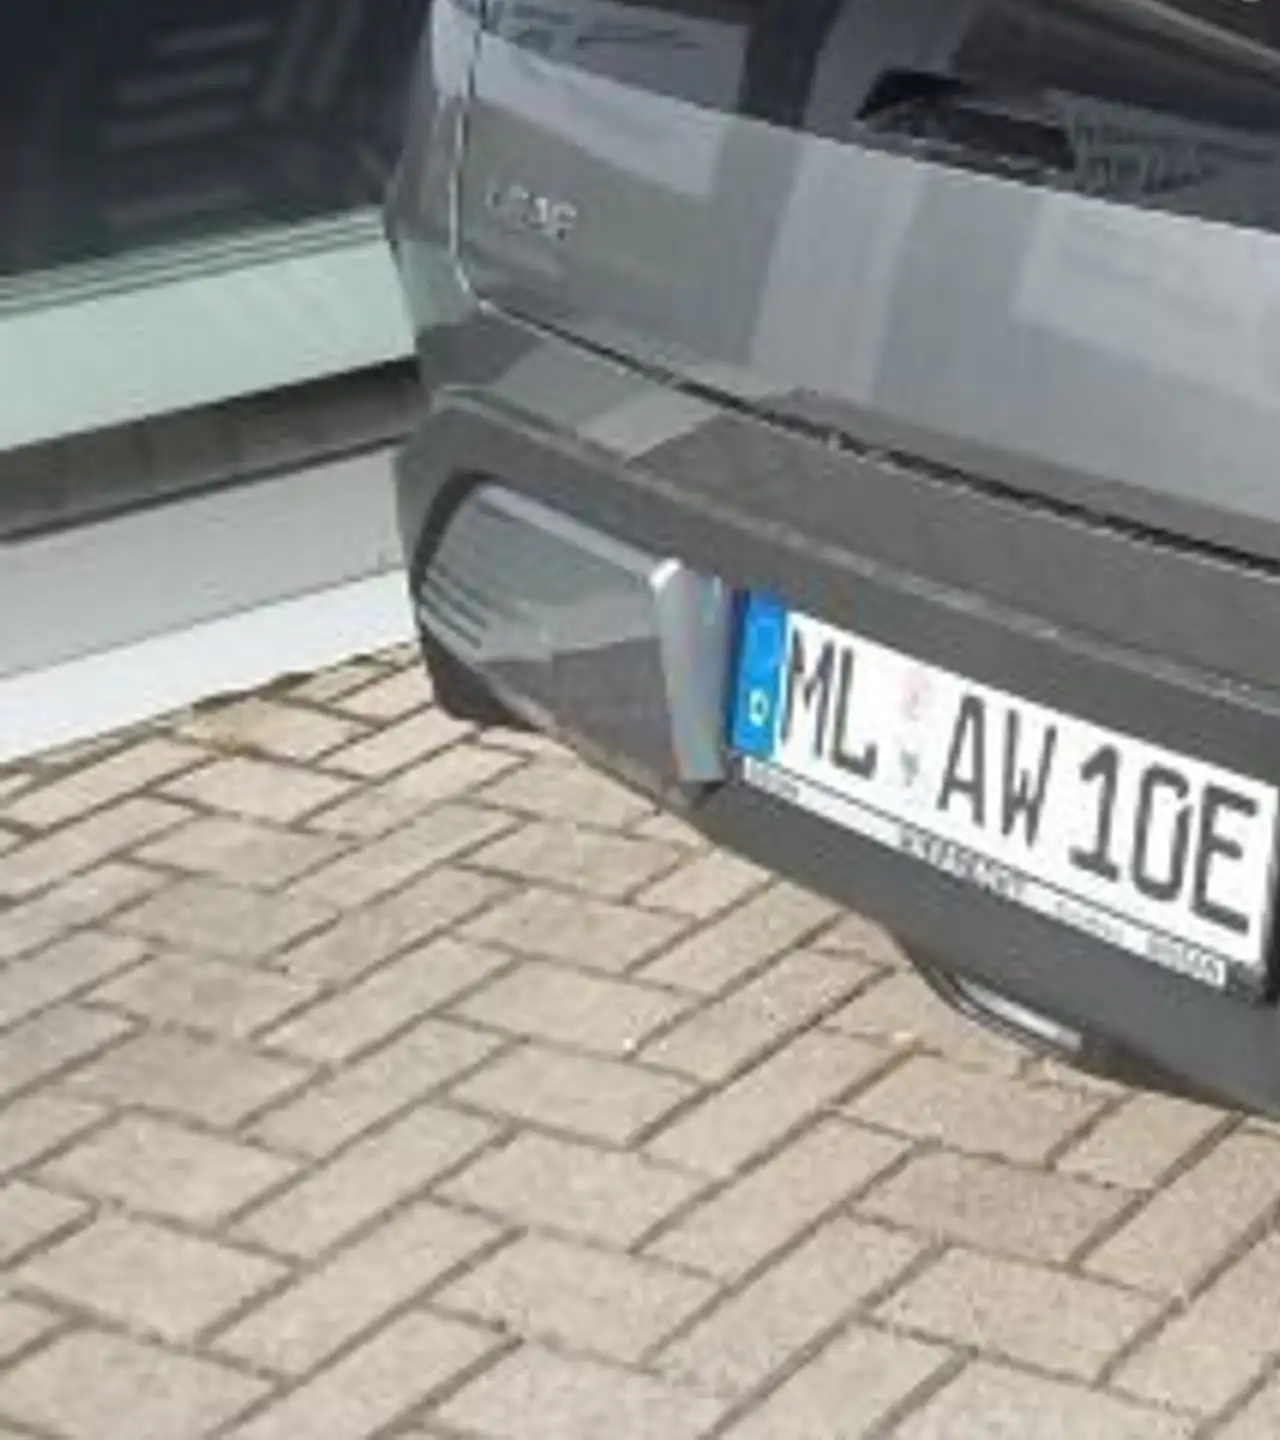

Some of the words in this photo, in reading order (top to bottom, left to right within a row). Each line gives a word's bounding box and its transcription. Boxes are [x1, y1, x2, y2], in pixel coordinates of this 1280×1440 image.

[780, 629, 877, 778] ML
[936, 695, 1058, 848] AW
[1069, 743, 1260, 936] 10E
